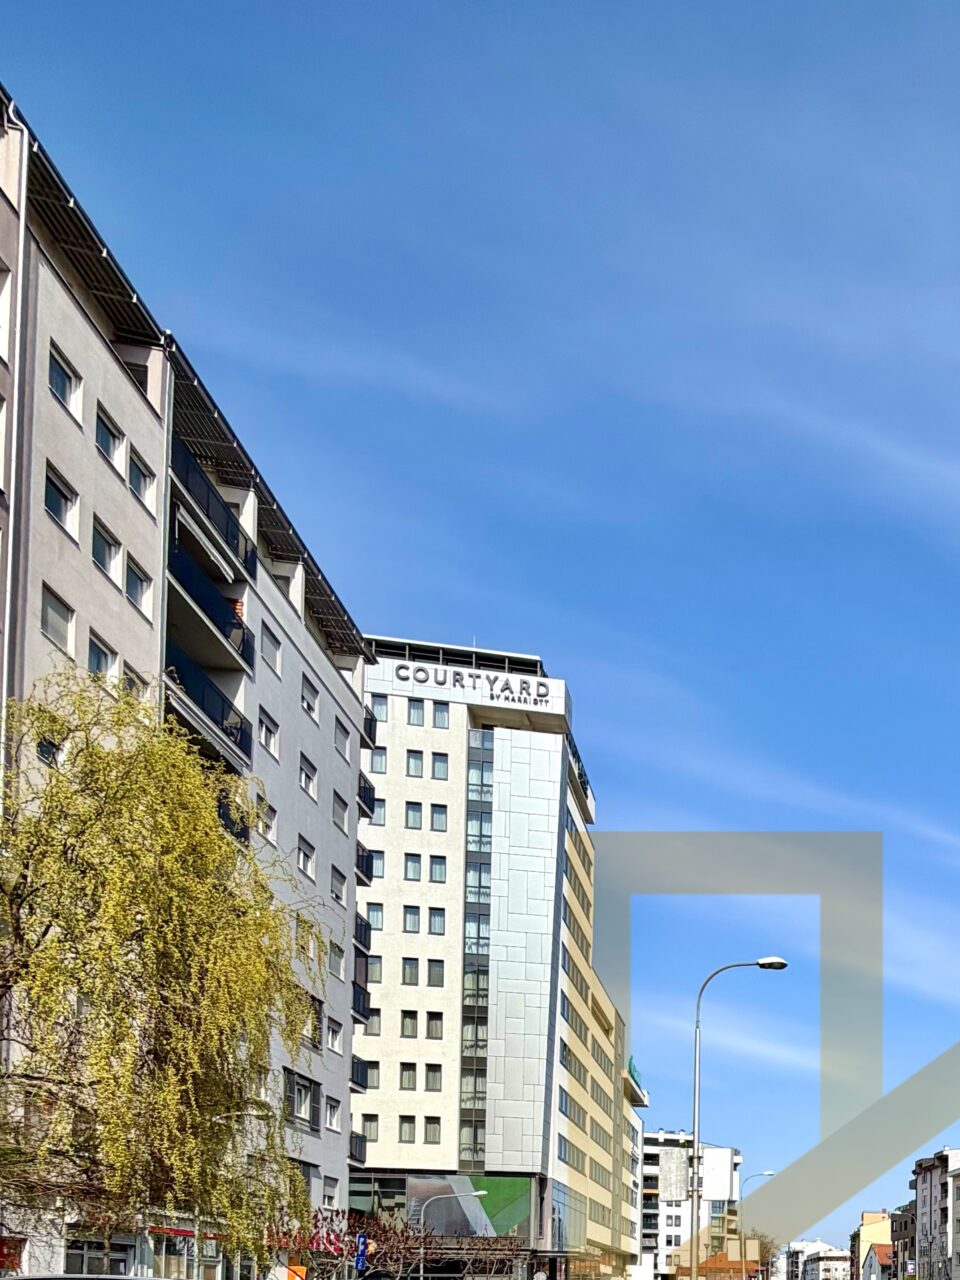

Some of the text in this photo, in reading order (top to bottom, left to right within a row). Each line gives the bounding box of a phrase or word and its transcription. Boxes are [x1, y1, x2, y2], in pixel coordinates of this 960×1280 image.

[395, 663, 550, 697] COURTYARD
[489, 692, 550, 707] BY MARRIOTT
